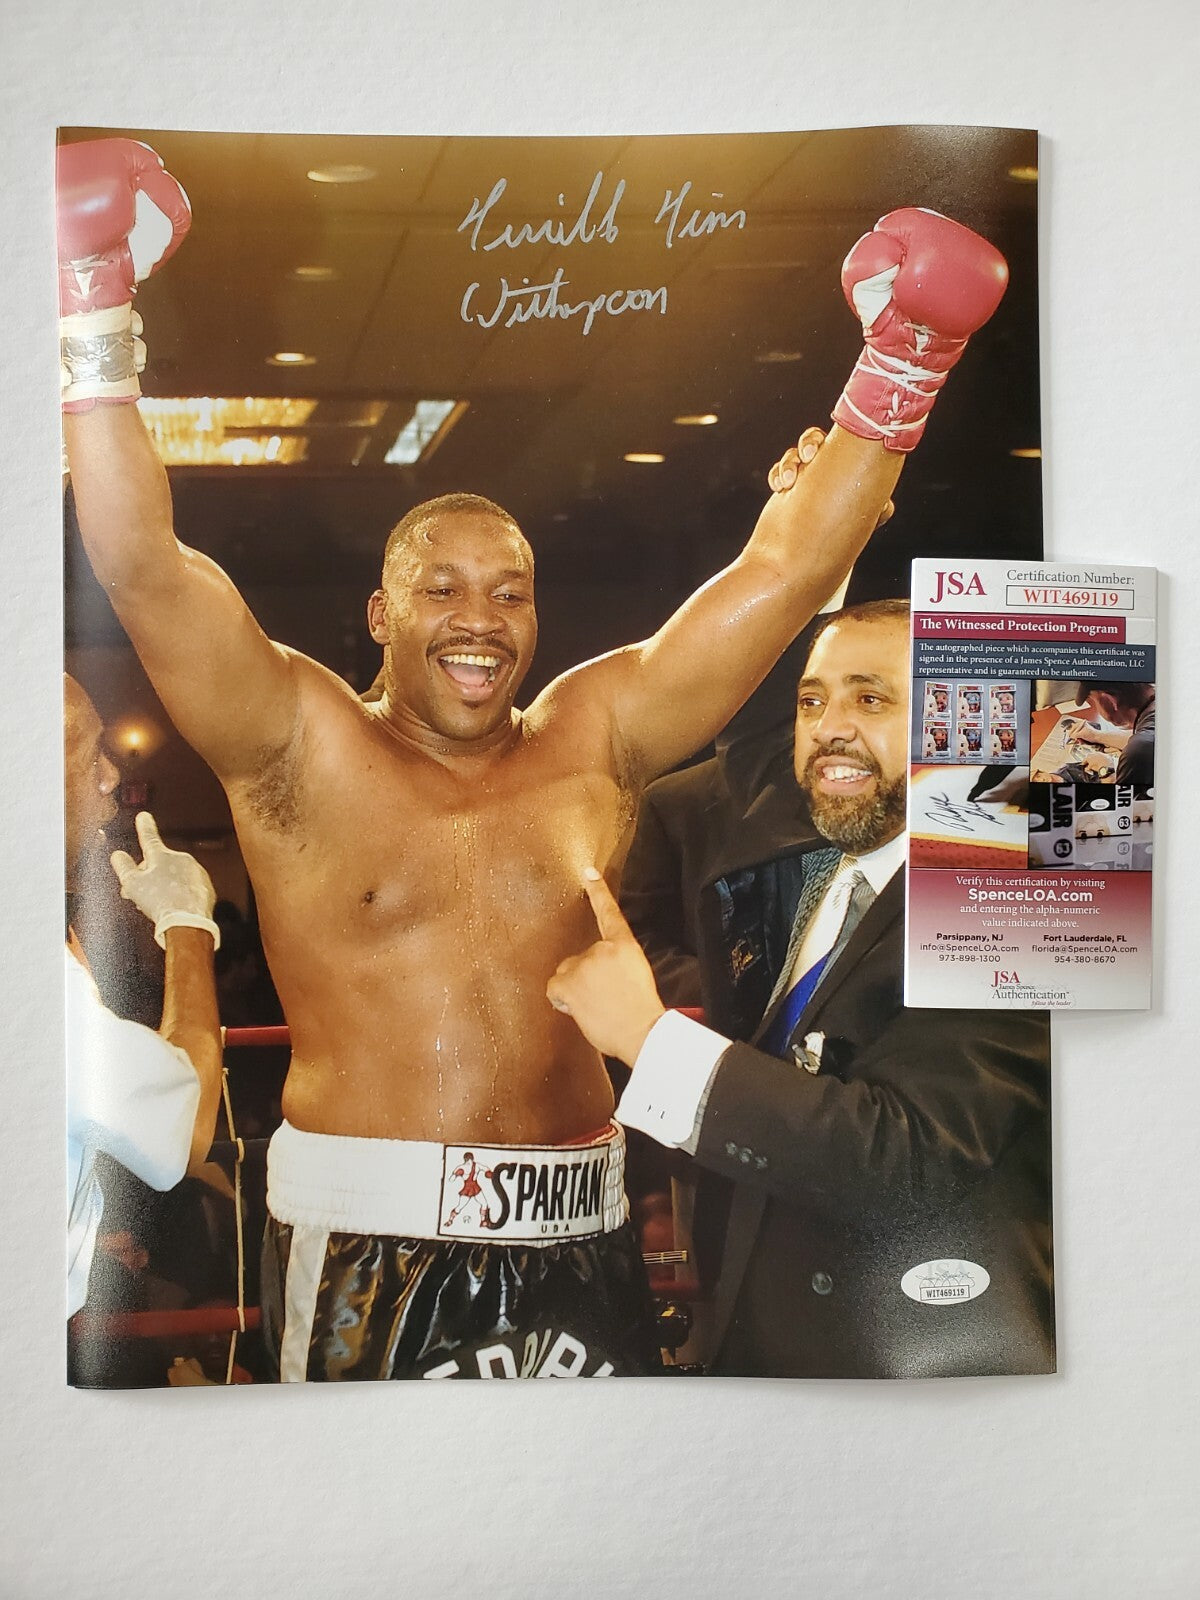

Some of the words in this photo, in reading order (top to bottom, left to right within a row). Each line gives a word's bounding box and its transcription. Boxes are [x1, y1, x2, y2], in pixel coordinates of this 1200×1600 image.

[1007, 569, 1080, 584] Certification
[1084, 572, 1135, 584] Number:
[930, 572, 987, 604] JSA
[1025, 589, 1118, 606] WIT469119
[920, 619, 942, 629] The
[945, 619, 1004, 630] Witnessed
[1008, 621, 1067, 632] Protection
[1070, 622, 1118, 635] Program
[936, 645, 983, 654] autographed
[986, 645, 1005, 654] piece
[1032, 646, 1078, 656] accompanies
[1095, 647, 1130, 656] certificate
[919, 655, 944, 664] signed
[970, 657, 1003, 665] presence
[1021, 657, 1042, 665] James
[1044, 658, 1070, 666] Spence
[1072, 658, 1127, 668] Authentication,
[919, 666, 972, 676] representative
[998, 667, 1039, 677] guaranteed
[1062, 668, 1097, 677] authentic.
[956, 876, 983, 887] Verify
[986, 876, 1002, 886] this
[1005, 877, 1058, 887] certification
[1061, 878, 1070, 889] by
[1073, 879, 1105, 889] visiting
[969, 889, 1093, 903] SpenceLOA.com
[960, 905, 977, 914] and
[980, 906, 1018, 916] entering
[1020, 906, 1034, 914] the
[1036, 906, 1100, 916] alpha-numeric
[982, 918, 1005, 927] value
[1008, 918, 1048, 927] indicated
[1052, 919, 1079, 928] above.
[936, 933, 989, 942] Parsippany,
[1064, 935, 1114, 944] Lauderdale,
[920, 943, 1019, 952] info@SpenceLOA.com
[1032, 945, 1137, 953] florida@SpenceLOA.com
[939, 955, 1000, 963] 973-898-1300
[991, 971, 1020, 987] JSA
[487, 1158, 604, 1230] SPARTAN
[926, 1288, 965, 1298] WIT469119
